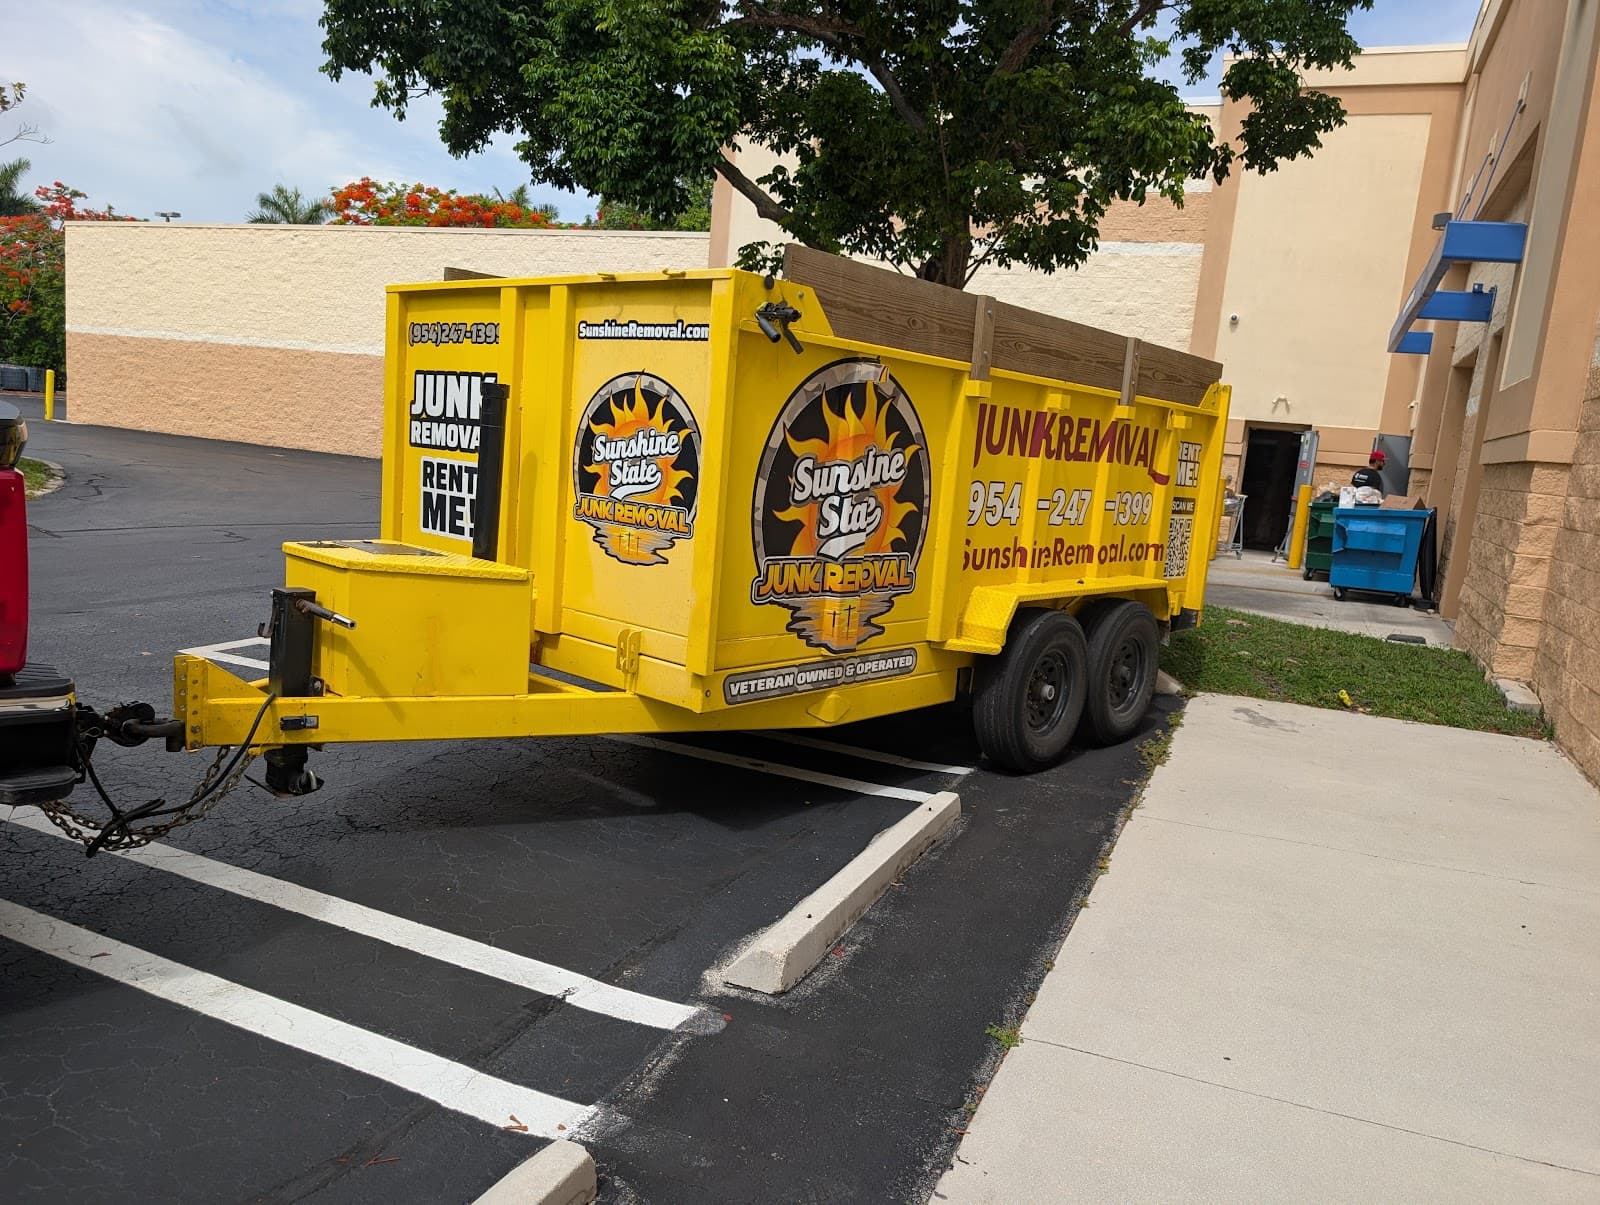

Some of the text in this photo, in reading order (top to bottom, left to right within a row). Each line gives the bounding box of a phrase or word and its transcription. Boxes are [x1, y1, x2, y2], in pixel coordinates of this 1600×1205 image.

[410, 420, 481, 450] REMOVA
[594, 428, 680, 462] Sunshine
[422, 460, 478, 495] RENT
[610, 461, 661, 487] State
[577, 497, 689, 533] JUNK REMOVAL
[1172, 500, 1186, 511] SCAN
[759, 558, 911, 595] JUNK REOVAL
[729, 654, 913, 696] VETERAN OWNED & OPERATED
